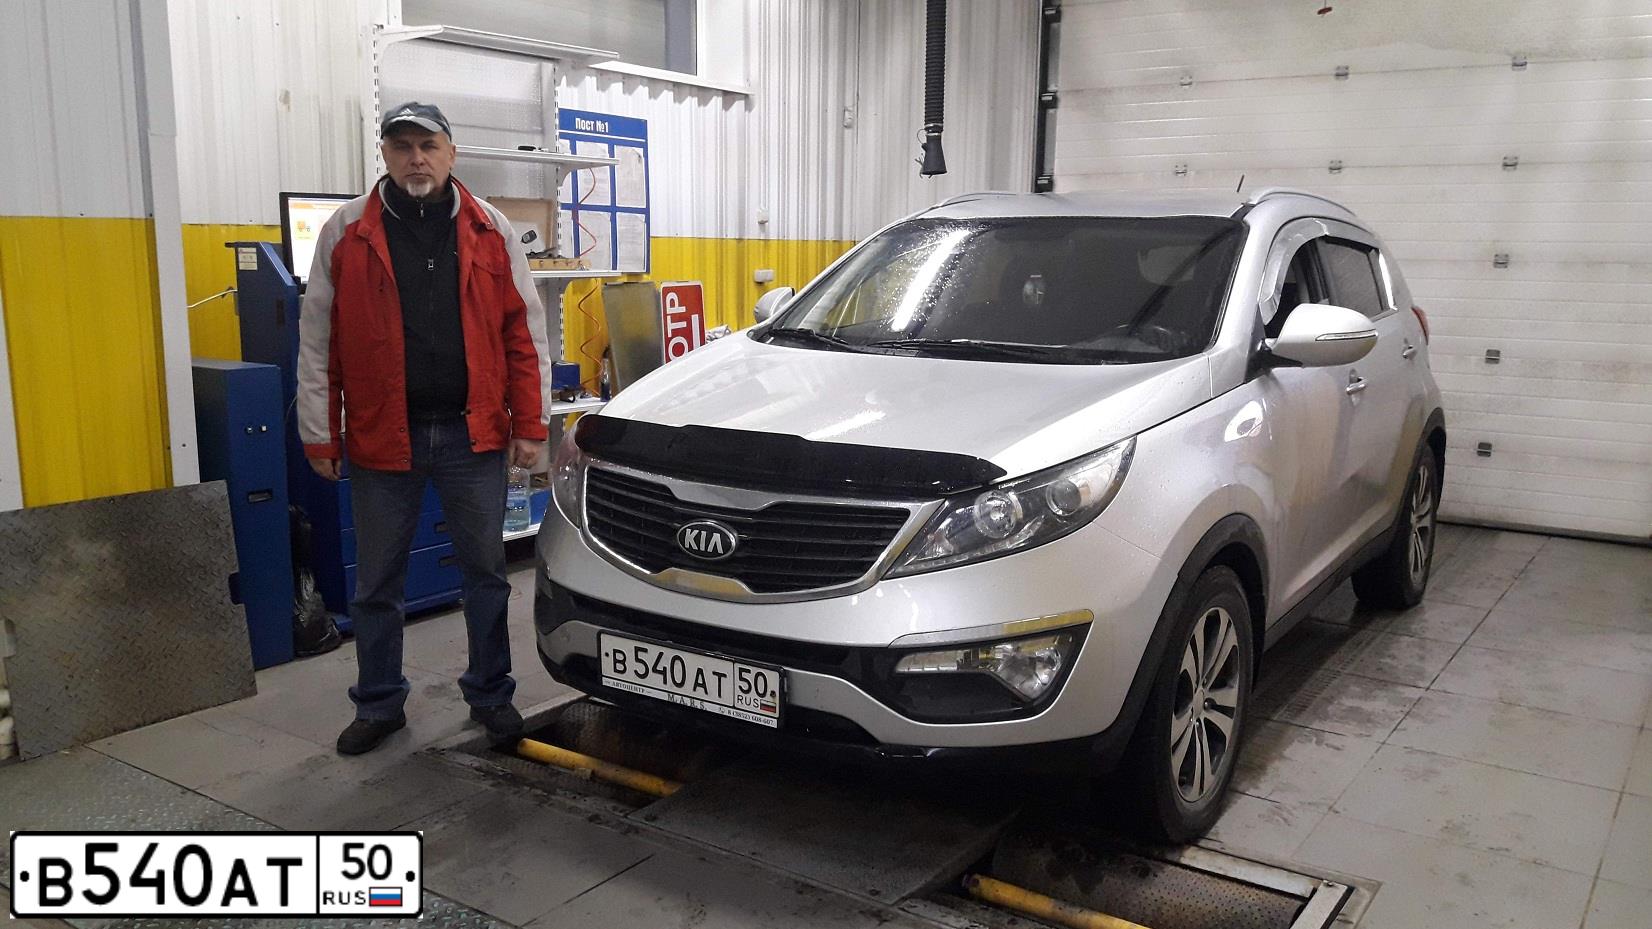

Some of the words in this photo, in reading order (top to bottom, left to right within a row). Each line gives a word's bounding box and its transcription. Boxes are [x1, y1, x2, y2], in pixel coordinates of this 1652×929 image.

[575, 117, 594, 131] Пост
[596, 120, 609, 133] №1
[684, 528, 724, 555] KIA
[738, 668, 768, 698] 50
[737, 694, 760, 708] RUS
